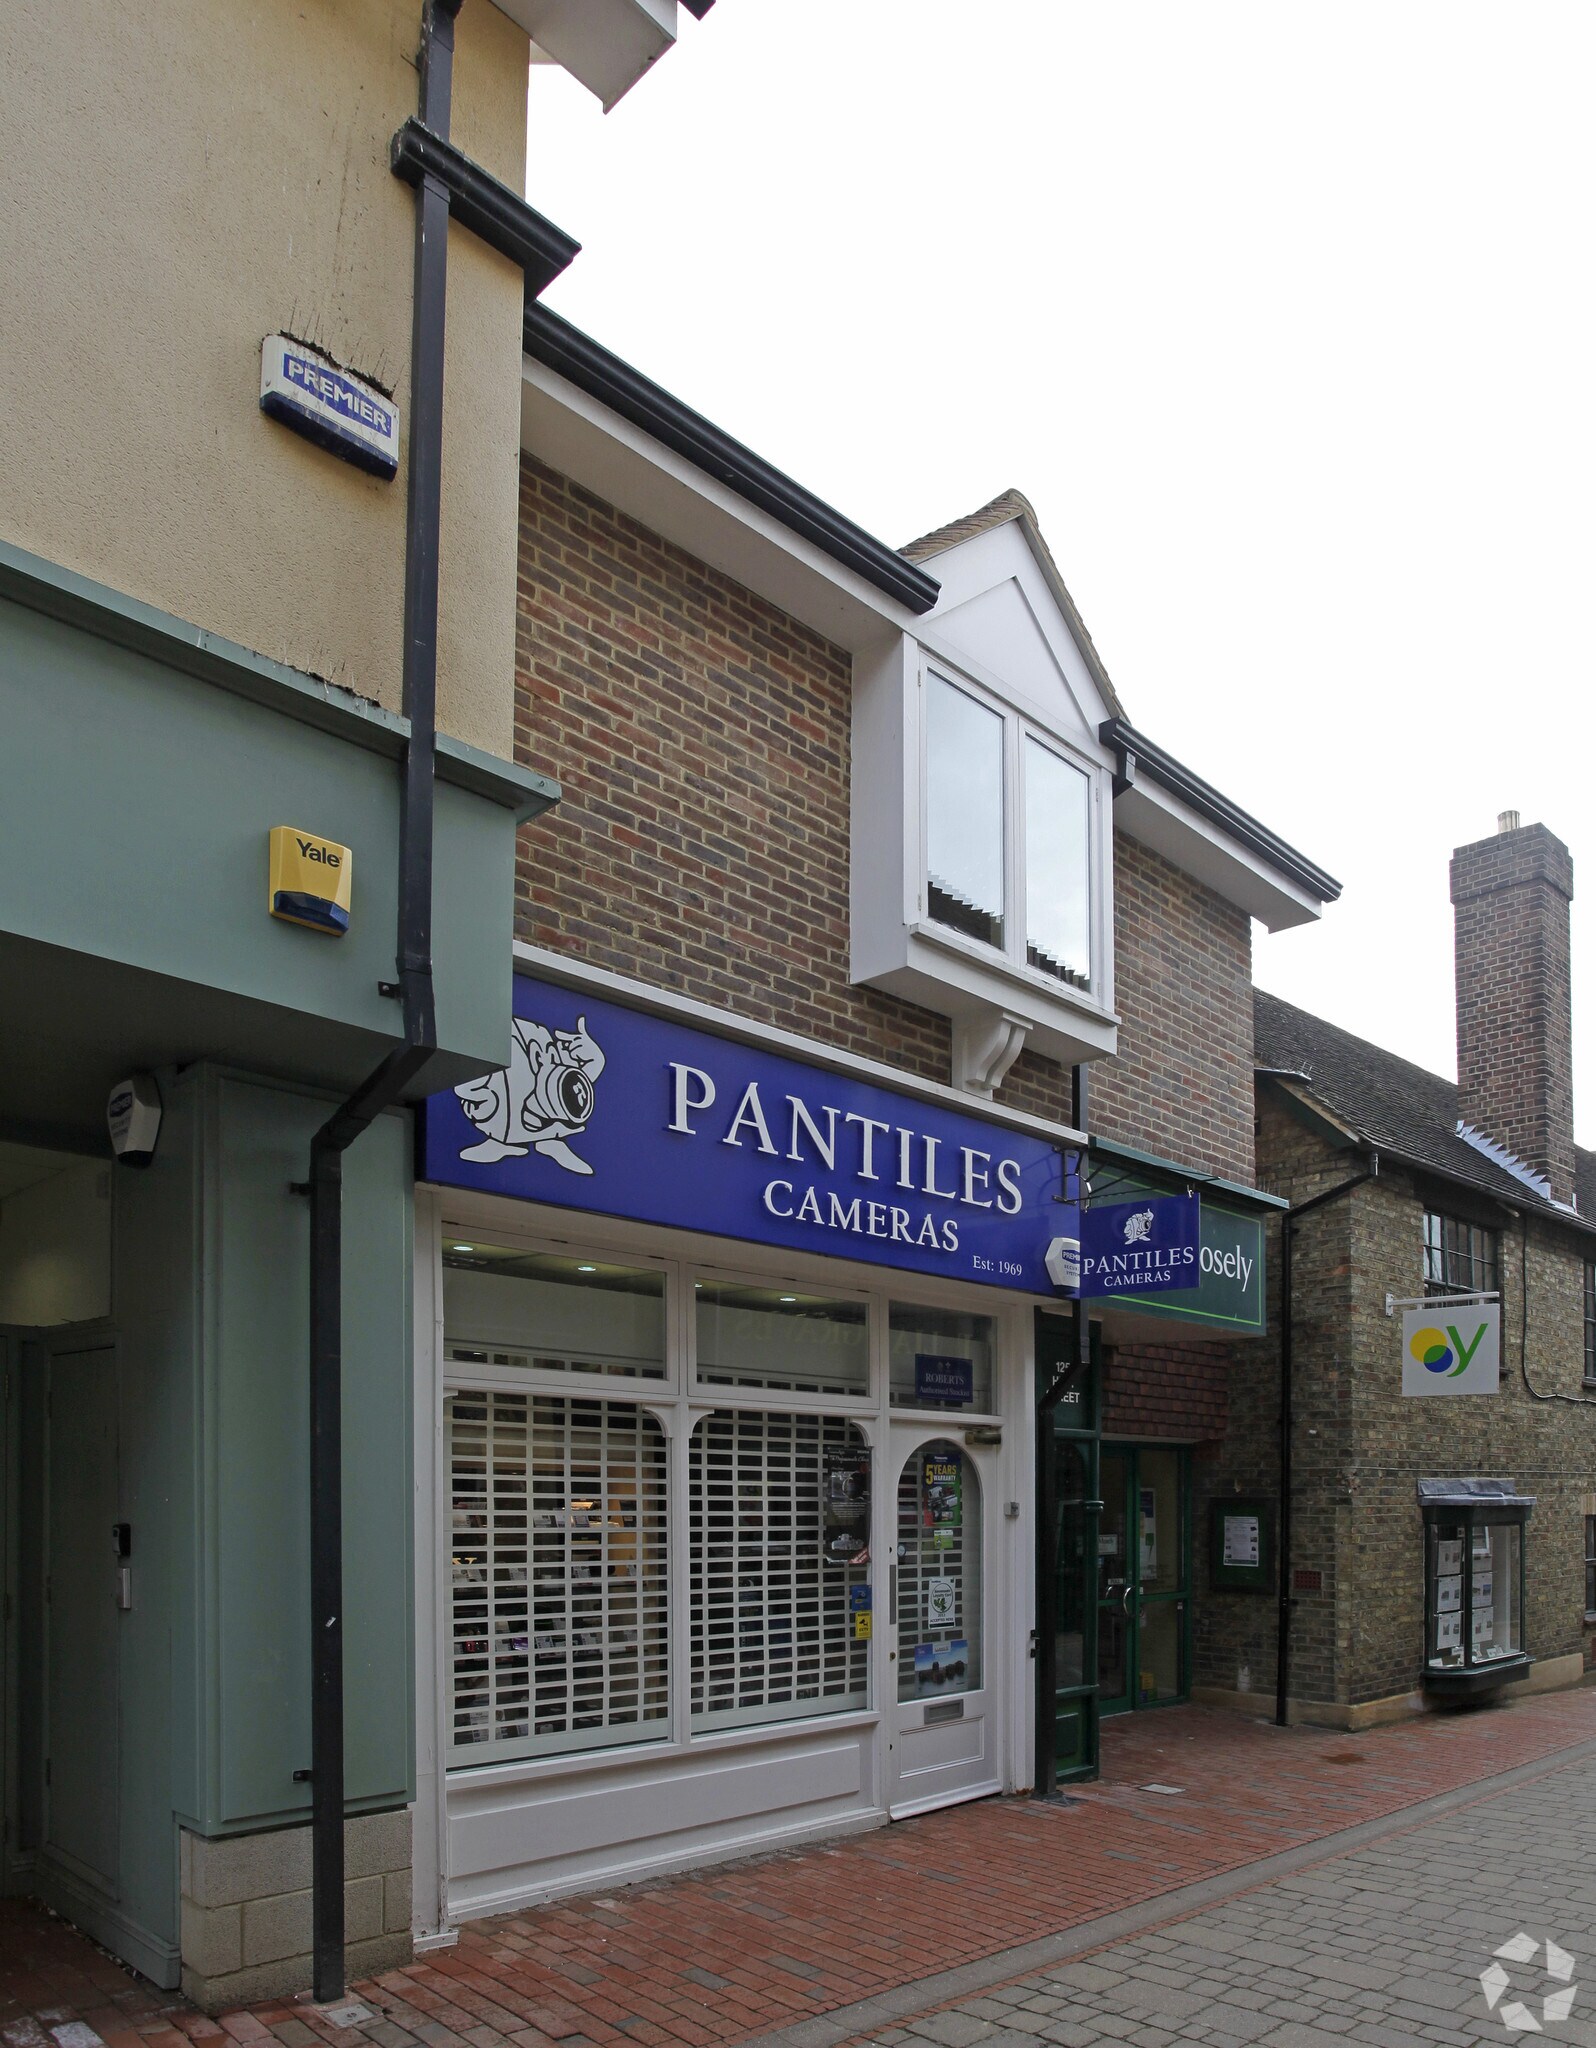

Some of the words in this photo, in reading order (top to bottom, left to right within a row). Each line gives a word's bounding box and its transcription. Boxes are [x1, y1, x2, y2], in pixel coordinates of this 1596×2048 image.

[288, 359, 388, 433] PREMIER
[296, 838, 340, 868] Yale
[667, 1062, 1023, 1215] PANTILES
[763, 1180, 960, 1252] CAMERAS
[972, 1255, 993, 1272] Est:
[997, 1259, 1023, 1276] 1969
[1083, 1246, 1195, 1275] PANTILES
[1200, 1245, 1253, 1292] osely
[1104, 1270, 1171, 1287] CAMERAS
[925, 1373, 964, 1385] ROBERTS
[926, 1464, 933, 1485] 5
[933, 1464, 957, 1475] YEARS
